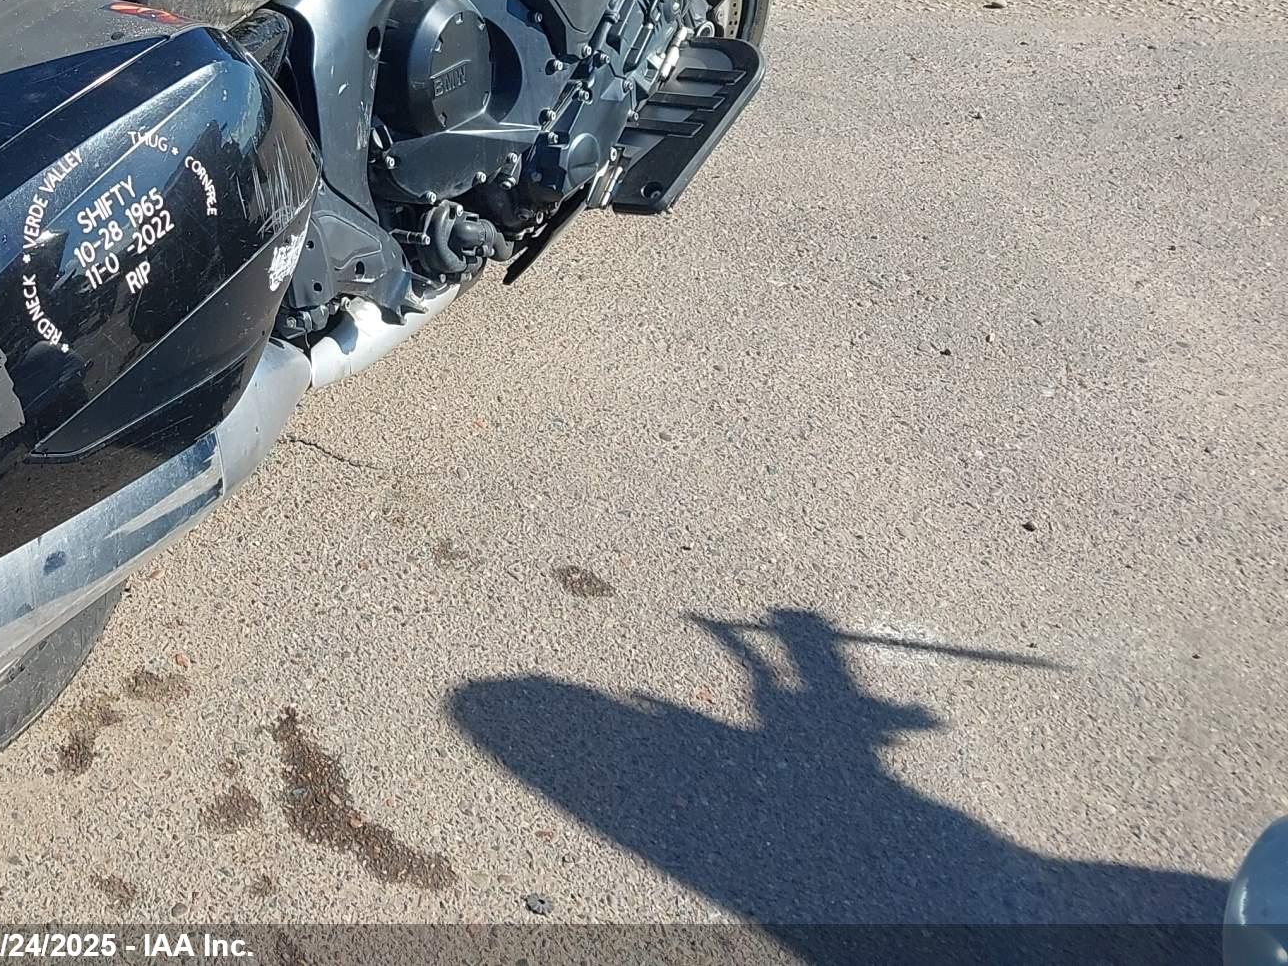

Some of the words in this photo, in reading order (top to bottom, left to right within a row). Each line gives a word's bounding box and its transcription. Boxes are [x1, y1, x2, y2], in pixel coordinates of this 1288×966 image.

[433, 65, 467, 97] BMW
[22, 193, 49, 250] VERDE
[38, 147, 83, 194] VALLEY
[127, 130, 168, 153] THUG
[77, 174, 136, 234] SHIFTY
[73, 220, 123, 268] 10-28
[125, 186, 163, 229] 1965
[125, 260, 151, 294] RIP
